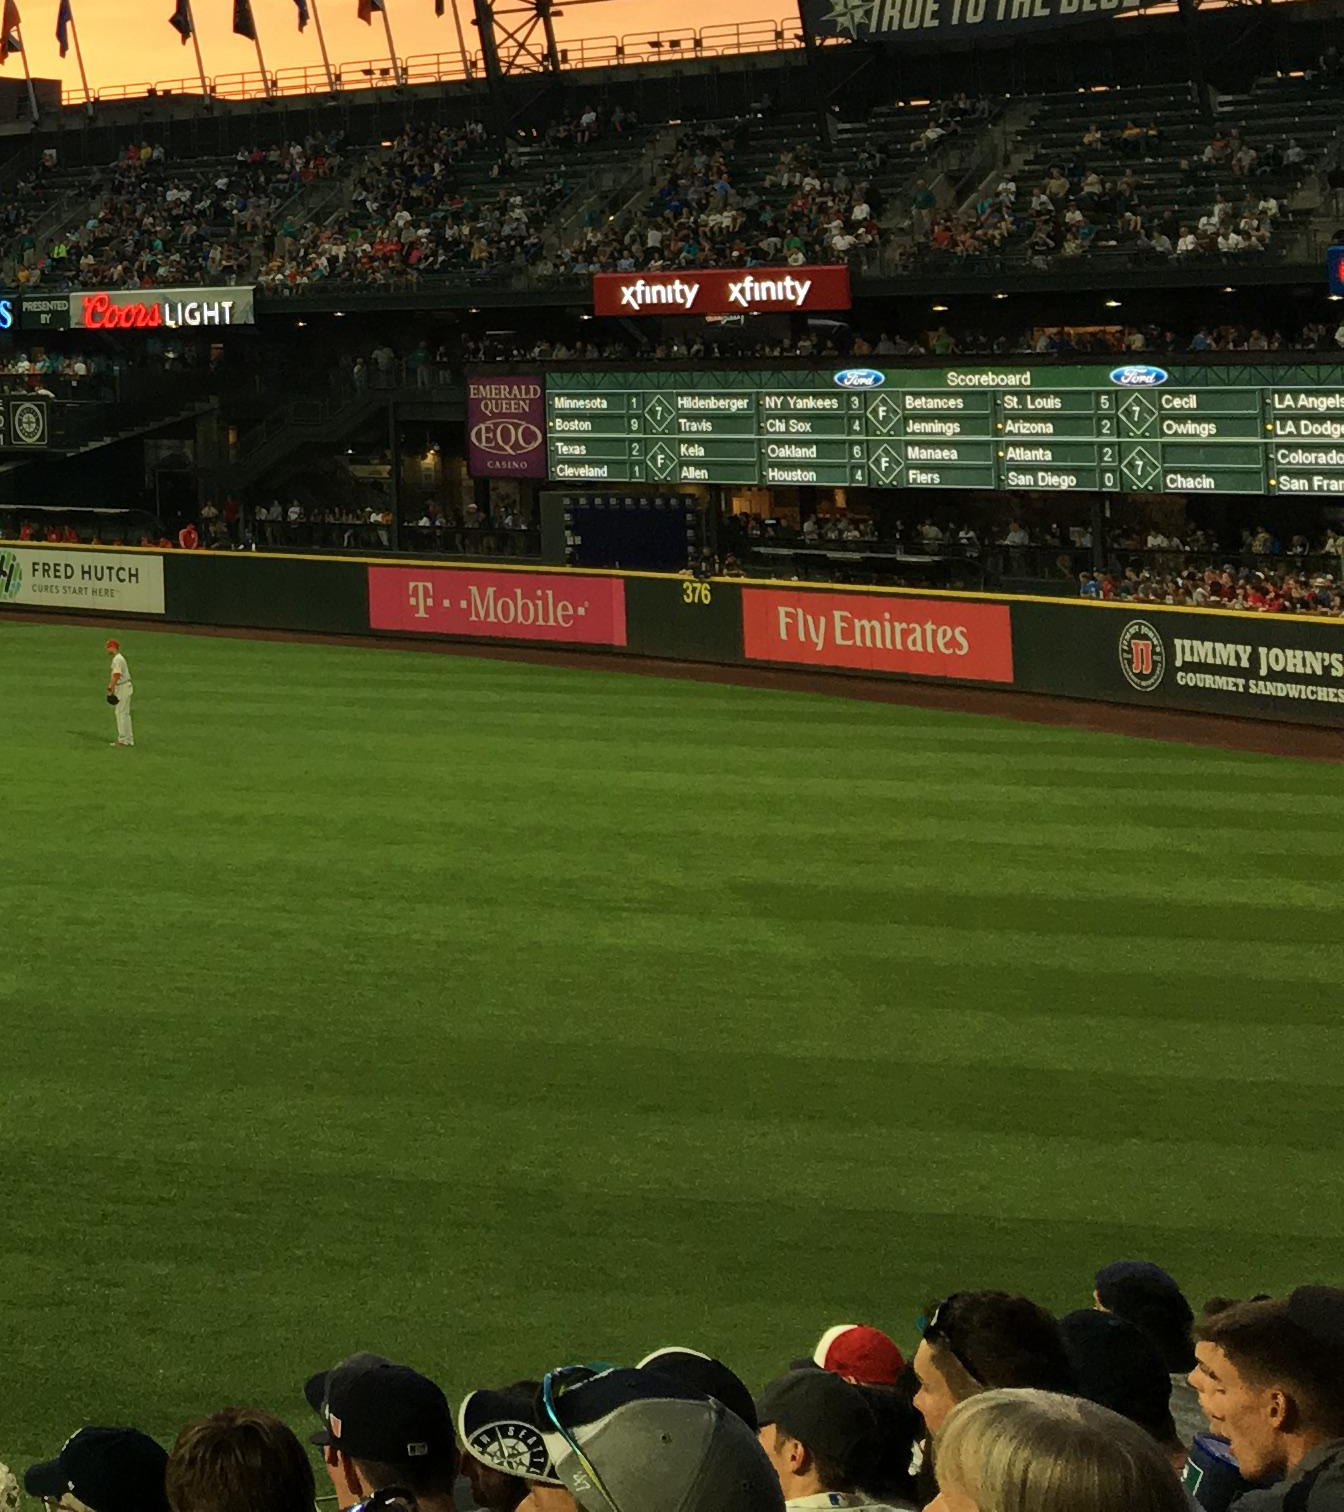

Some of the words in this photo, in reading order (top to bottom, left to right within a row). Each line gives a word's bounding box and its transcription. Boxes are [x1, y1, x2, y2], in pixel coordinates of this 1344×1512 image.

[621, 279, 700, 310] xfinity
[728, 275, 812, 308] xfinity
[23, 300, 69, 312] PRESENTED
[81, 292, 161, 329] Coors
[164, 301, 233, 327] LIGHT
[40, 312, 52, 324] BY
[843, 370, 875, 386] Ford
[947, 371, 1031, 386] Scoreboard
[1120, 368, 1156, 384] Ford
[469, 385, 541, 398] EMERALD
[480, 400, 530, 416] QUEEN
[554, 397, 607, 409] Minnesota
[631, 397, 637, 408] 1
[678, 395, 749, 412] Hildenberger
[765, 396, 784, 409] NY
[787, 395, 839, 409] Yankees
[851, 396, 859, 408] 3
[905, 395, 963, 409] Betances
[1004, 395, 1023, 409] St.
[1027, 395, 1062, 409] Louis
[1100, 395, 1109, 409] 5
[1162, 394, 1197, 409] Cecil
[1274, 393, 1295, 408] LA
[1297, 393, 1344, 412] Angels
[655, 407, 663, 420] 7
[878, 406, 887, 420] F
[1132, 407, 1140, 421] 7
[555, 419, 591, 431] Boston
[631, 419, 639, 430] 9
[679, 419, 712, 432] Travis
[767, 419, 786, 432] Chi
[789, 419, 812, 432] Sox
[853, 420, 860, 431] 4
[906, 420, 960, 436] Jennings
[1005, 420, 1054, 434] Arizona
[1101, 420, 1110, 433] 2
[1163, 420, 1217, 437] Owings
[1276, 420, 1297, 435] LA
[478, 423, 539, 455] EQC
[555, 443, 586, 455] Texas
[632, 443, 639, 455] 2
[680, 444, 705, 457] Kela
[767, 445, 817, 458] Oakland
[853, 445, 861, 457] 6
[907, 446, 958, 460] Manaea
[1006, 447, 1052, 461] Atlanta
[1103, 448, 1112, 461] 2
[657, 455, 665, 468] F
[1277, 449, 1344, 464] Colorado
[487, 460, 528, 469] CASINO
[556, 464, 608, 477] Cleveland
[634, 466, 640, 477] 1
[881, 457, 890, 471] F
[1135, 461, 1143, 476] 7
[681, 466, 708, 479] Allen
[768, 468, 817, 482] Houston
[855, 469, 862, 481] 4
[909, 469, 940, 484] Fiers
[1008, 472, 1034, 486] San
[1038, 472, 1077, 489] Diego
[1105, 473, 1113, 486] 0
[1166, 474, 1215, 489] Chacin
[1279, 476, 1309, 491] San
[32, 562, 75, 579] FRED
[81, 565, 140, 584] HUTCH
[32, 584, 60, 594] CURES
[62, 586, 88, 596] START
[683, 583, 711, 605] 376
[777, 606, 826, 651] Fly
[833, 610, 970, 656] Emirates
[1174, 638, 1252, 669] JIMMY
[1258, 646, 1344, 678] JOHN'S
[1177, 671, 1246, 694] GOURMET
[1248, 679, 1344, 703] SANDWICHES
